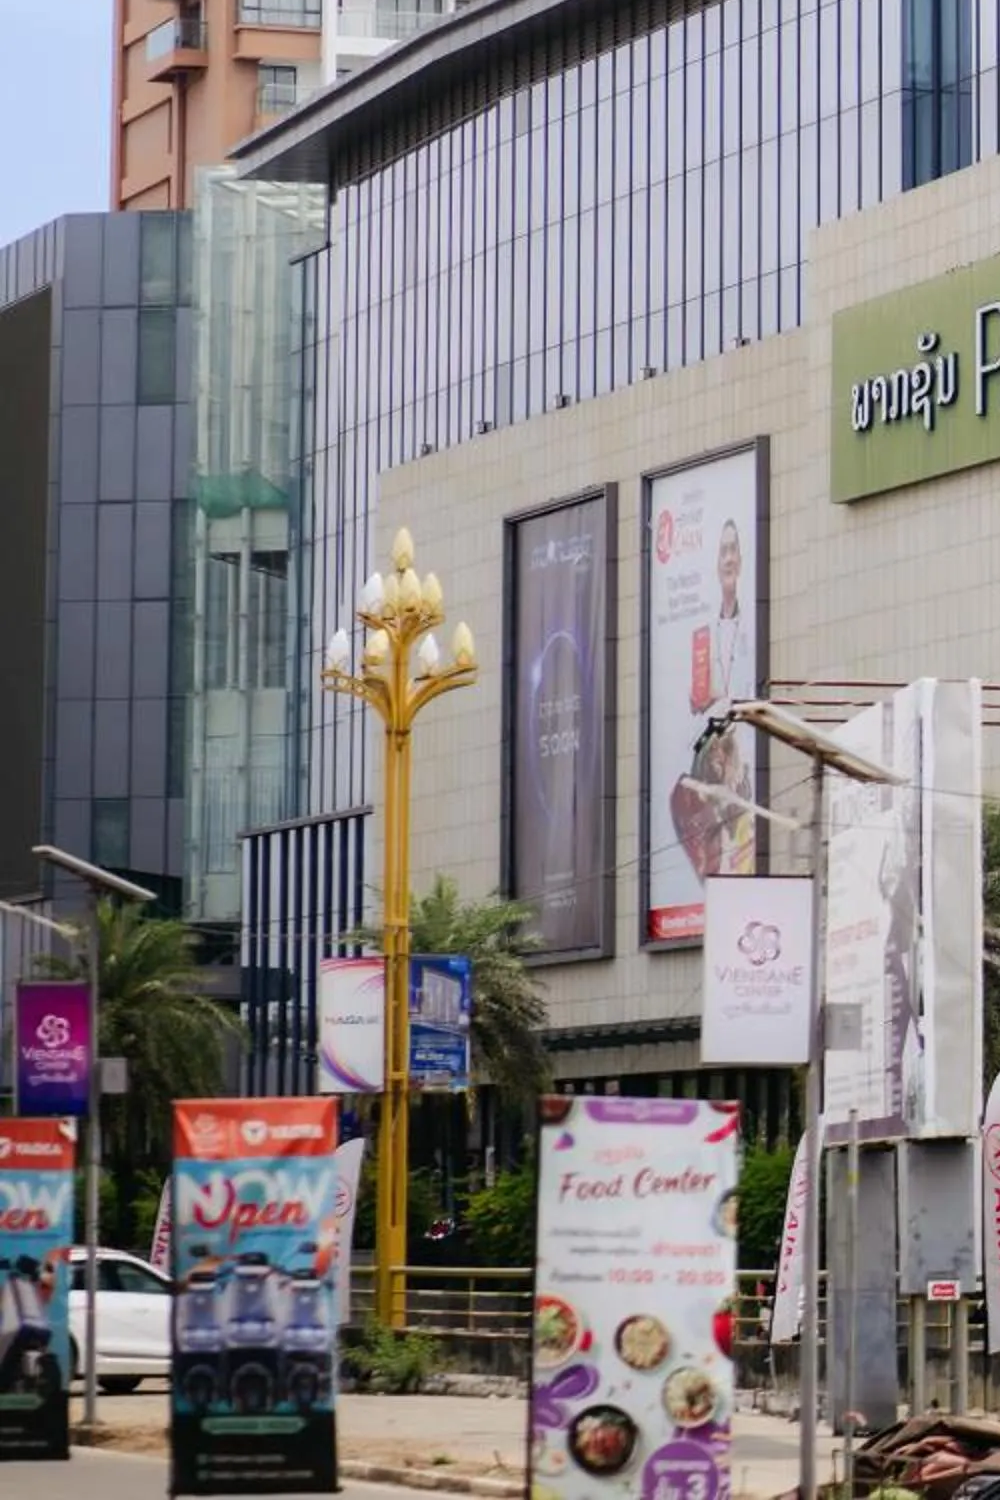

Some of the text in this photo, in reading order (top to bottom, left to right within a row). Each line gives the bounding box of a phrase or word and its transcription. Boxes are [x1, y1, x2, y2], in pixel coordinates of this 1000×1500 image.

[559, 1165, 717, 1203] Food Center
[192, 1178, 310, 1246] Open
